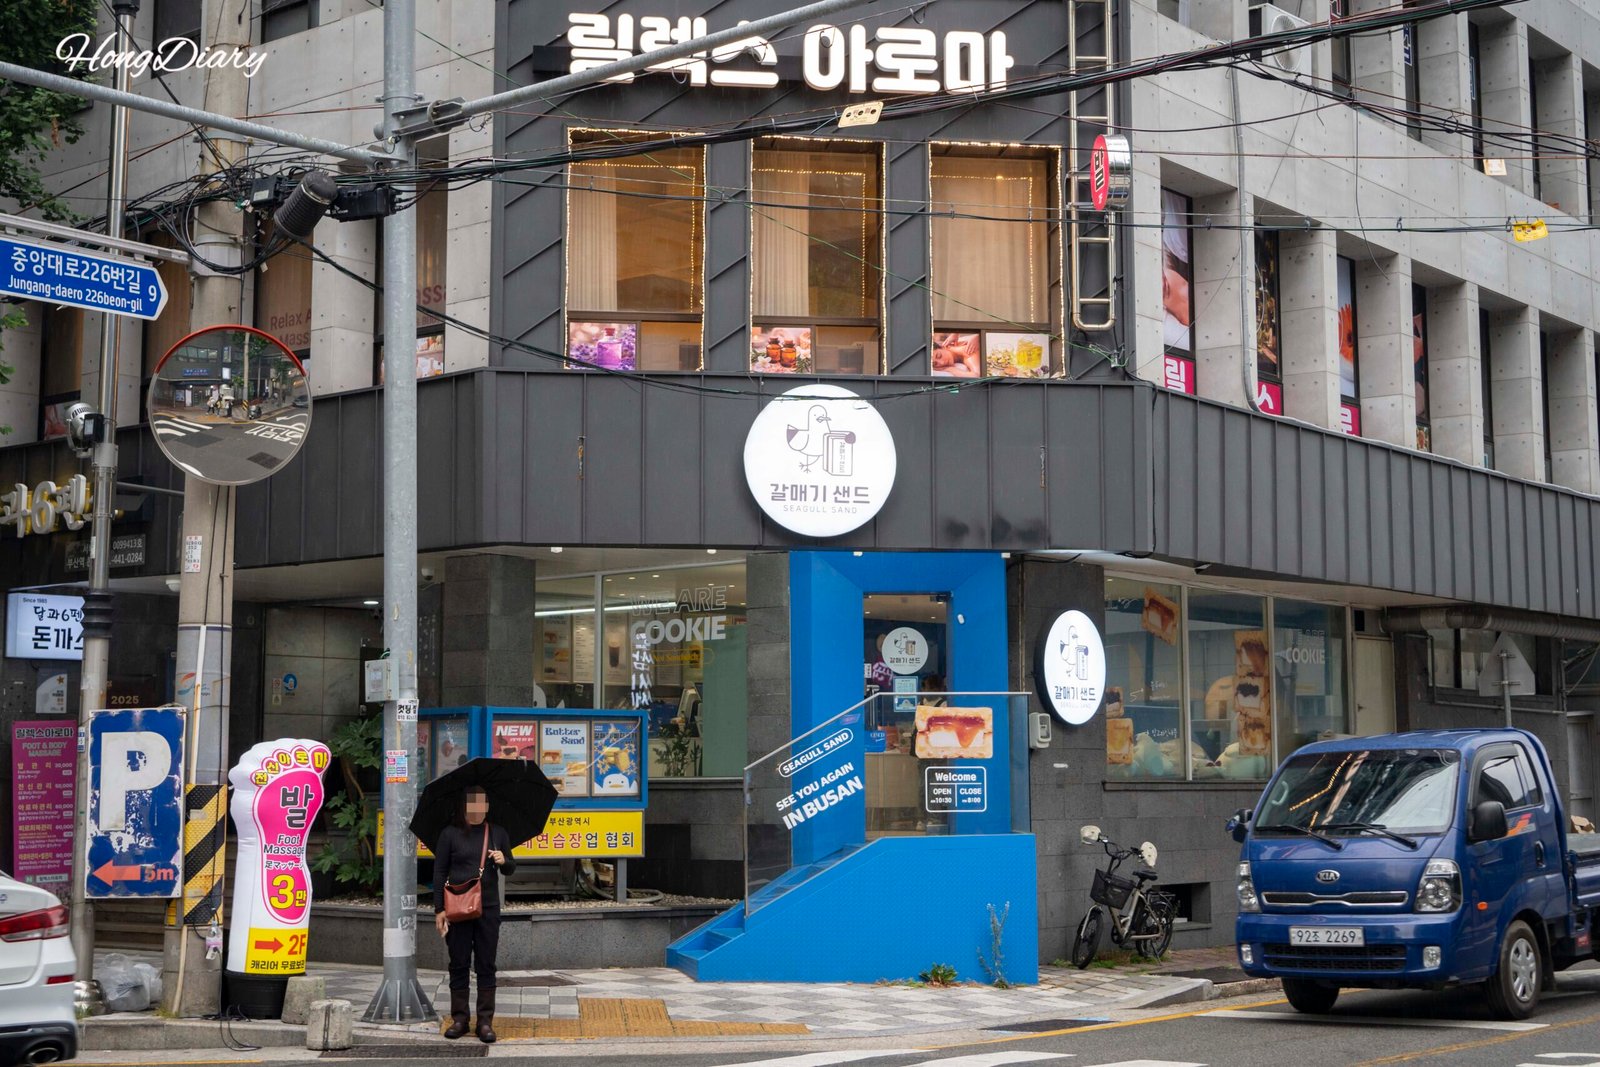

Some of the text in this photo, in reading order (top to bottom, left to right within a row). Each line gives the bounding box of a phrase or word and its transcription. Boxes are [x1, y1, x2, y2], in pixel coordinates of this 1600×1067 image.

[567, 12, 1015, 94] 릴렉스 아로마
[11, 246, 157, 302] 중앙대로226번길 9
[8, 274, 143, 313] Jungang-daero 226beon-gil
[270, 313, 303, 331] Relax
[770, 483, 871, 504] 갈매기 샌드
[783, 504, 858, 514] SEAGULL SAND
[110, 552, 143, 565] -441-0284
[674, 585, 727, 614] ARE
[629, 615, 727, 645] COOKIE
[1286, 647, 1326, 665] COOKIE
[111, 695, 140, 705] 2025
[1054, 685, 1096, 701] 갈매기 샌드
[16, 727, 74, 739] 릴렉스아로마
[495, 725, 533, 736] NEW
[545, 727, 581, 736] Butter
[22, 741, 41, 750] FOOT
[48, 741, 67, 749] BODY
[560, 736, 585, 745] Sand
[782, 732, 849, 774] SEAGULL SAND
[99, 731, 172, 831] P
[935, 772, 977, 781] Welcome
[776, 762, 855, 811] SEE YOU AGAIN
[281, 785, 314, 829] 발
[782, 776, 864, 830] IN BUSAN
[549, 817, 590, 826] 부산광역시
[278, 834, 300, 844] Foot
[606, 832, 634, 848] 협회
[1319, 872, 1338, 881] KIA
[287, 934, 306, 955] 2F
[1296, 930, 1356, 943] 92조 2269
[250, 960, 278, 970] 캐리어
